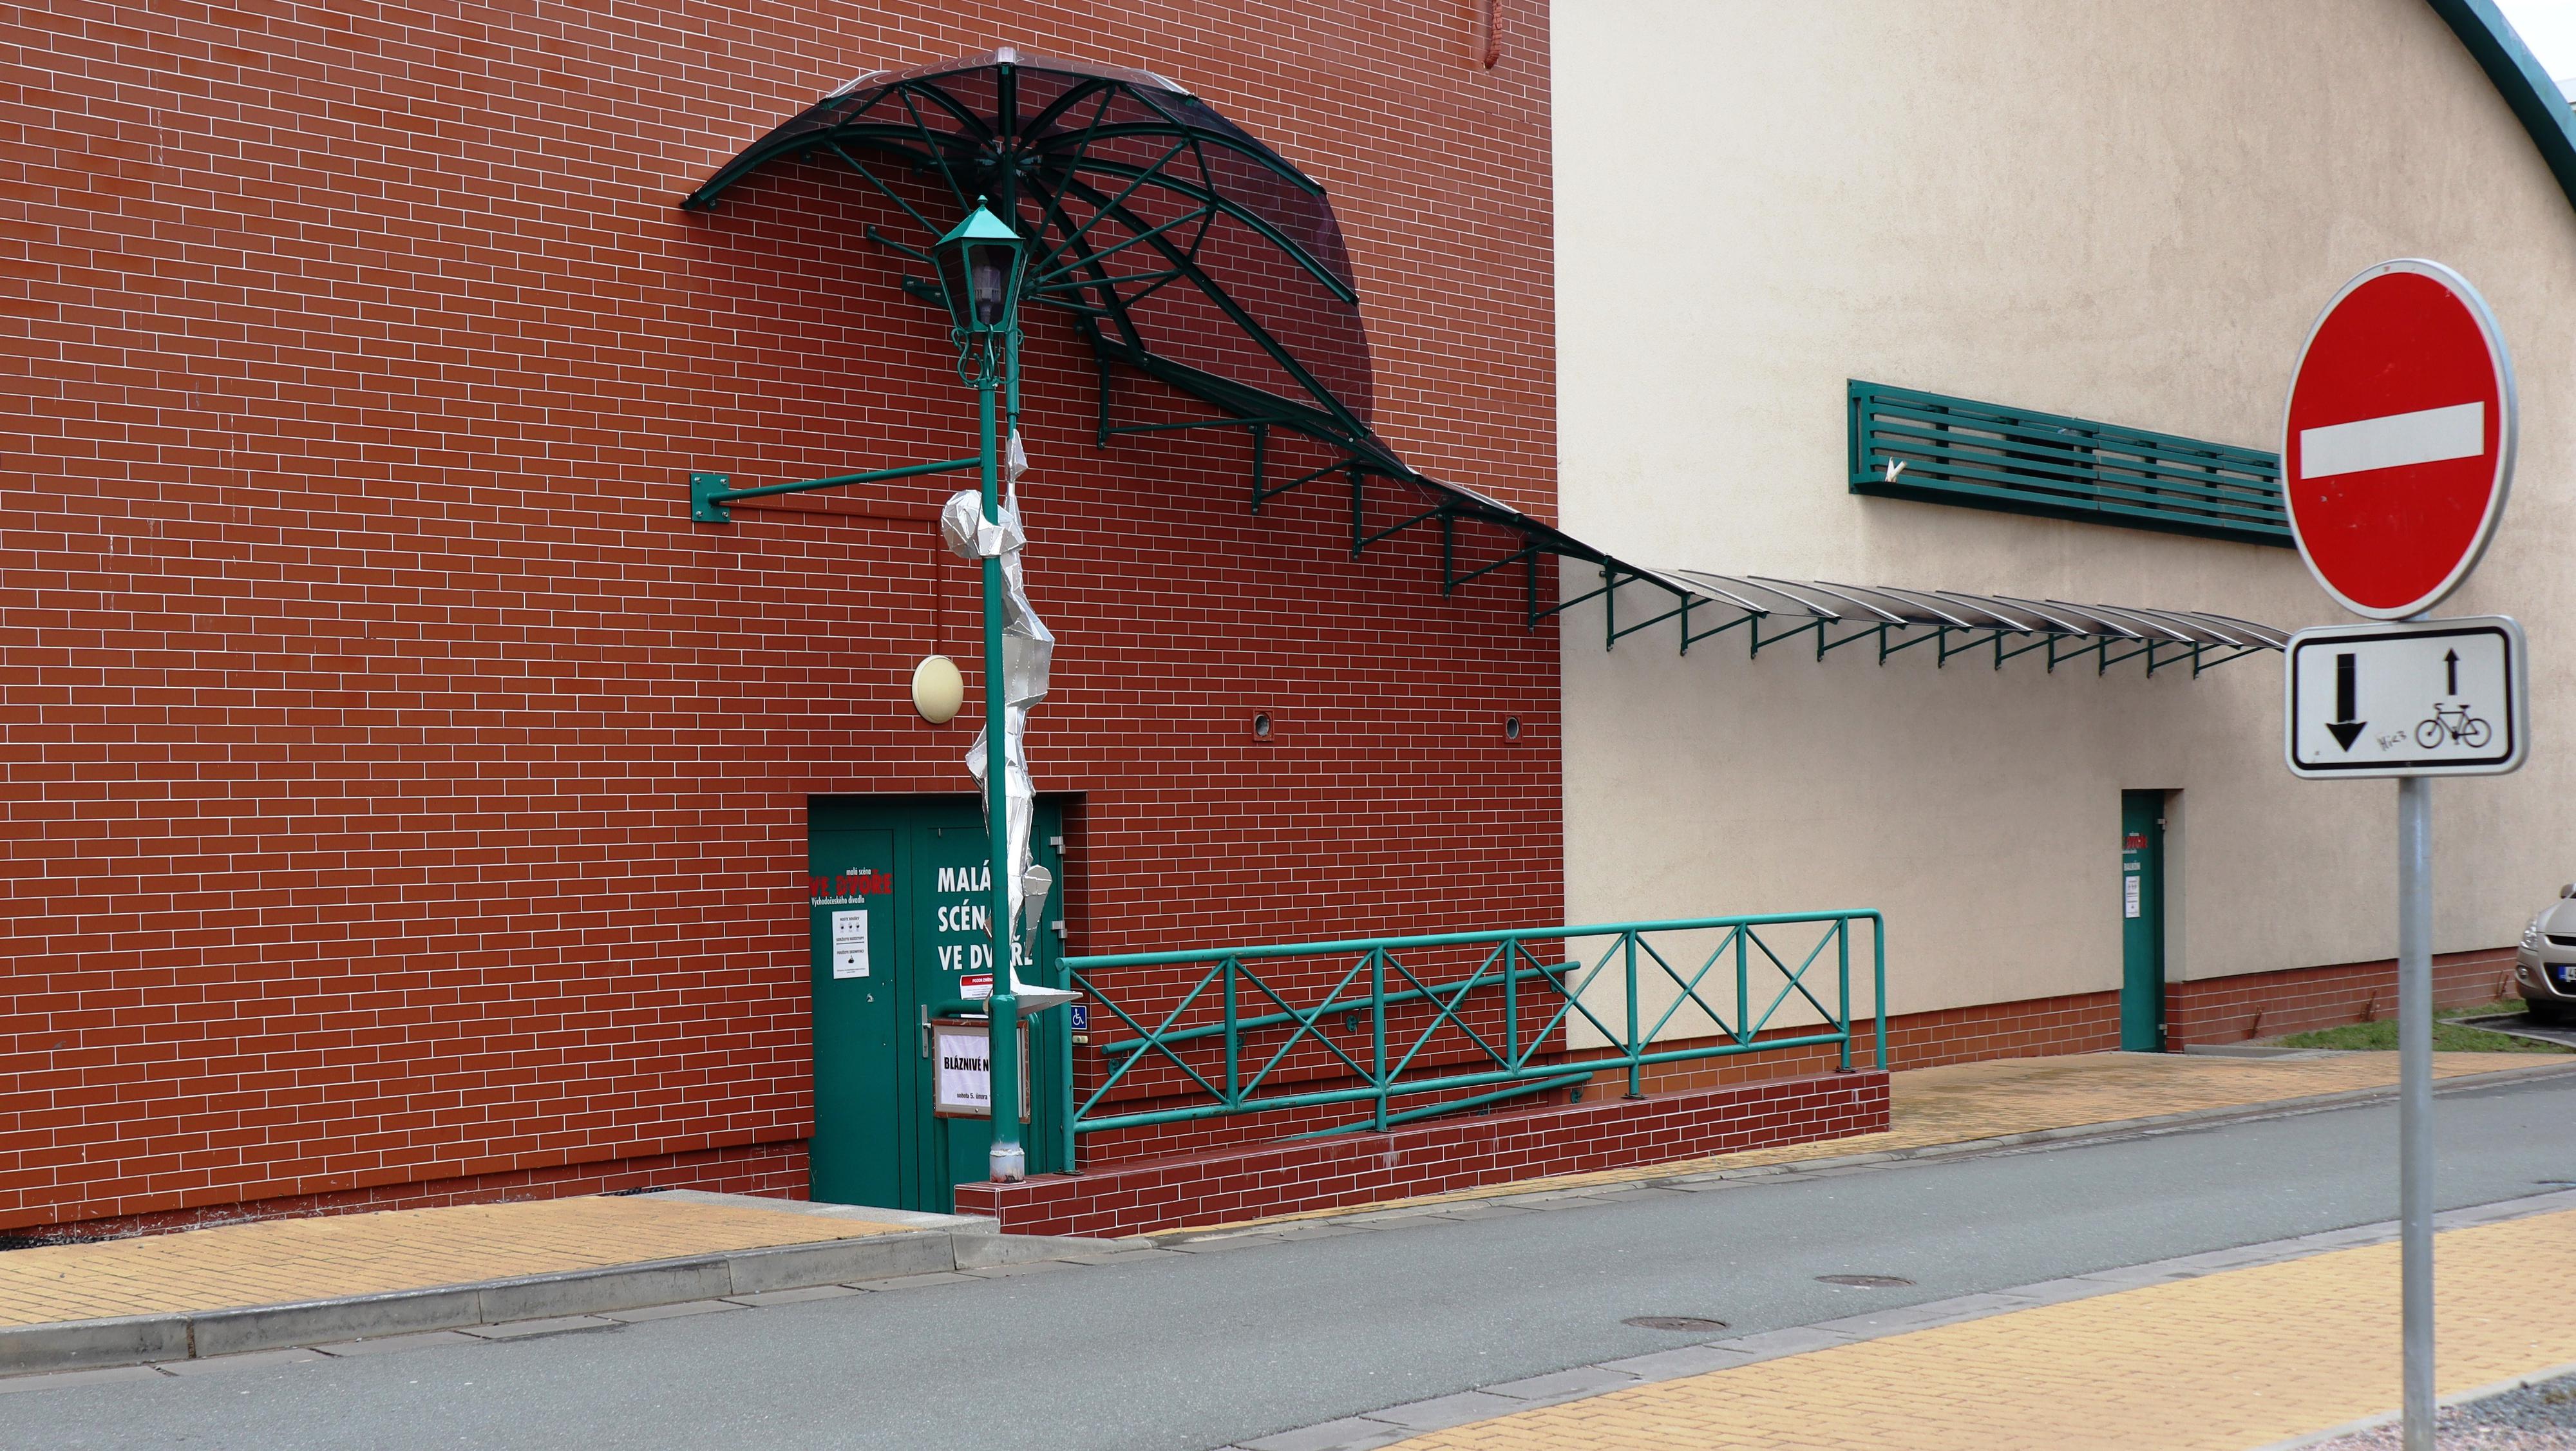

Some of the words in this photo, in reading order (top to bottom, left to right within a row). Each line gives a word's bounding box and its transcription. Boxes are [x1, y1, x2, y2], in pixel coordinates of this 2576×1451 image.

[809, 876, 829, 897] VE
[835, 869, 892, 896] DVOŘE
[846, 867, 858, 875] malá
[858, 867, 871, 875] scéna
[938, 860, 990, 892] MALÁ
[811, 895, 848, 907] Východočeského
[848, 895, 865, 904] divadla
[938, 899, 991, 932] SCÉN
[938, 945, 962, 971] VE
[944, 1055, 981, 1071] BLÁZNIVÉ
